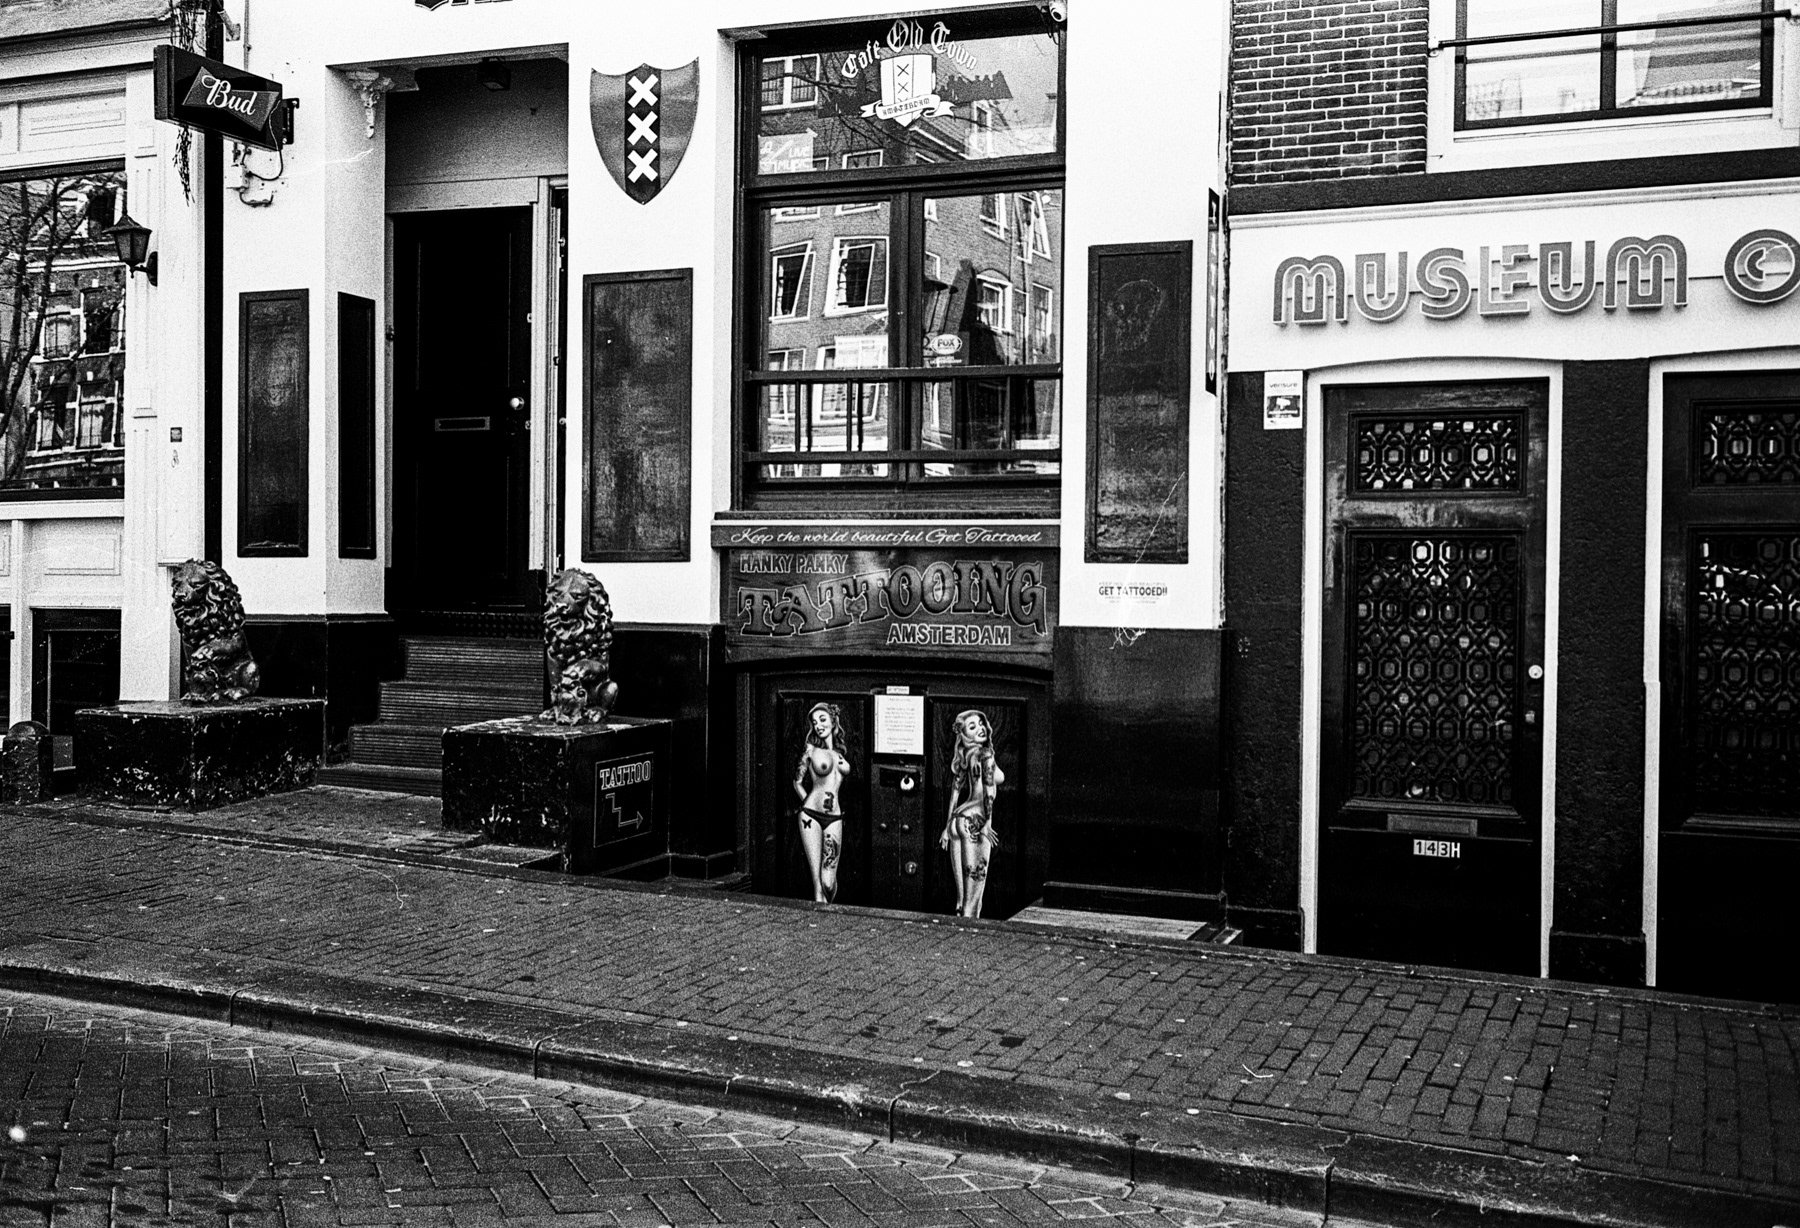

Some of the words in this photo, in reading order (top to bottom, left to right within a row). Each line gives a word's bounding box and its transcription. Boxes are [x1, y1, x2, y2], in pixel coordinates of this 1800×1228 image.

[841, 39, 881, 78] Cafe
[886, 18, 924, 53] Old
[930, 21, 977, 70] Town
[201, 75, 258, 115] Bud
[1273, 234, 1689, 326] MUSEUM
[937, 338, 955, 347] FOX
[730, 527, 774, 545] Keep
[776, 531, 801, 543] the
[802, 531, 850, 543] world
[850, 530, 924, 546] beautiful
[925, 528, 963, 544] Get
[965, 527, 1042, 544] Tattooed
[739, 553, 794, 574] HANKY
[795, 553, 849, 574] PANKY
[737, 560, 1048, 638] TATTOOING
[1098, 586, 1114, 596] GET
[1116, 586, 1168, 596] TATTOOED!!
[886, 623, 1011, 646] AMSTERDAM
[599, 760, 651, 790] TATTOO
[1416, 840, 1461, 859] 143H
